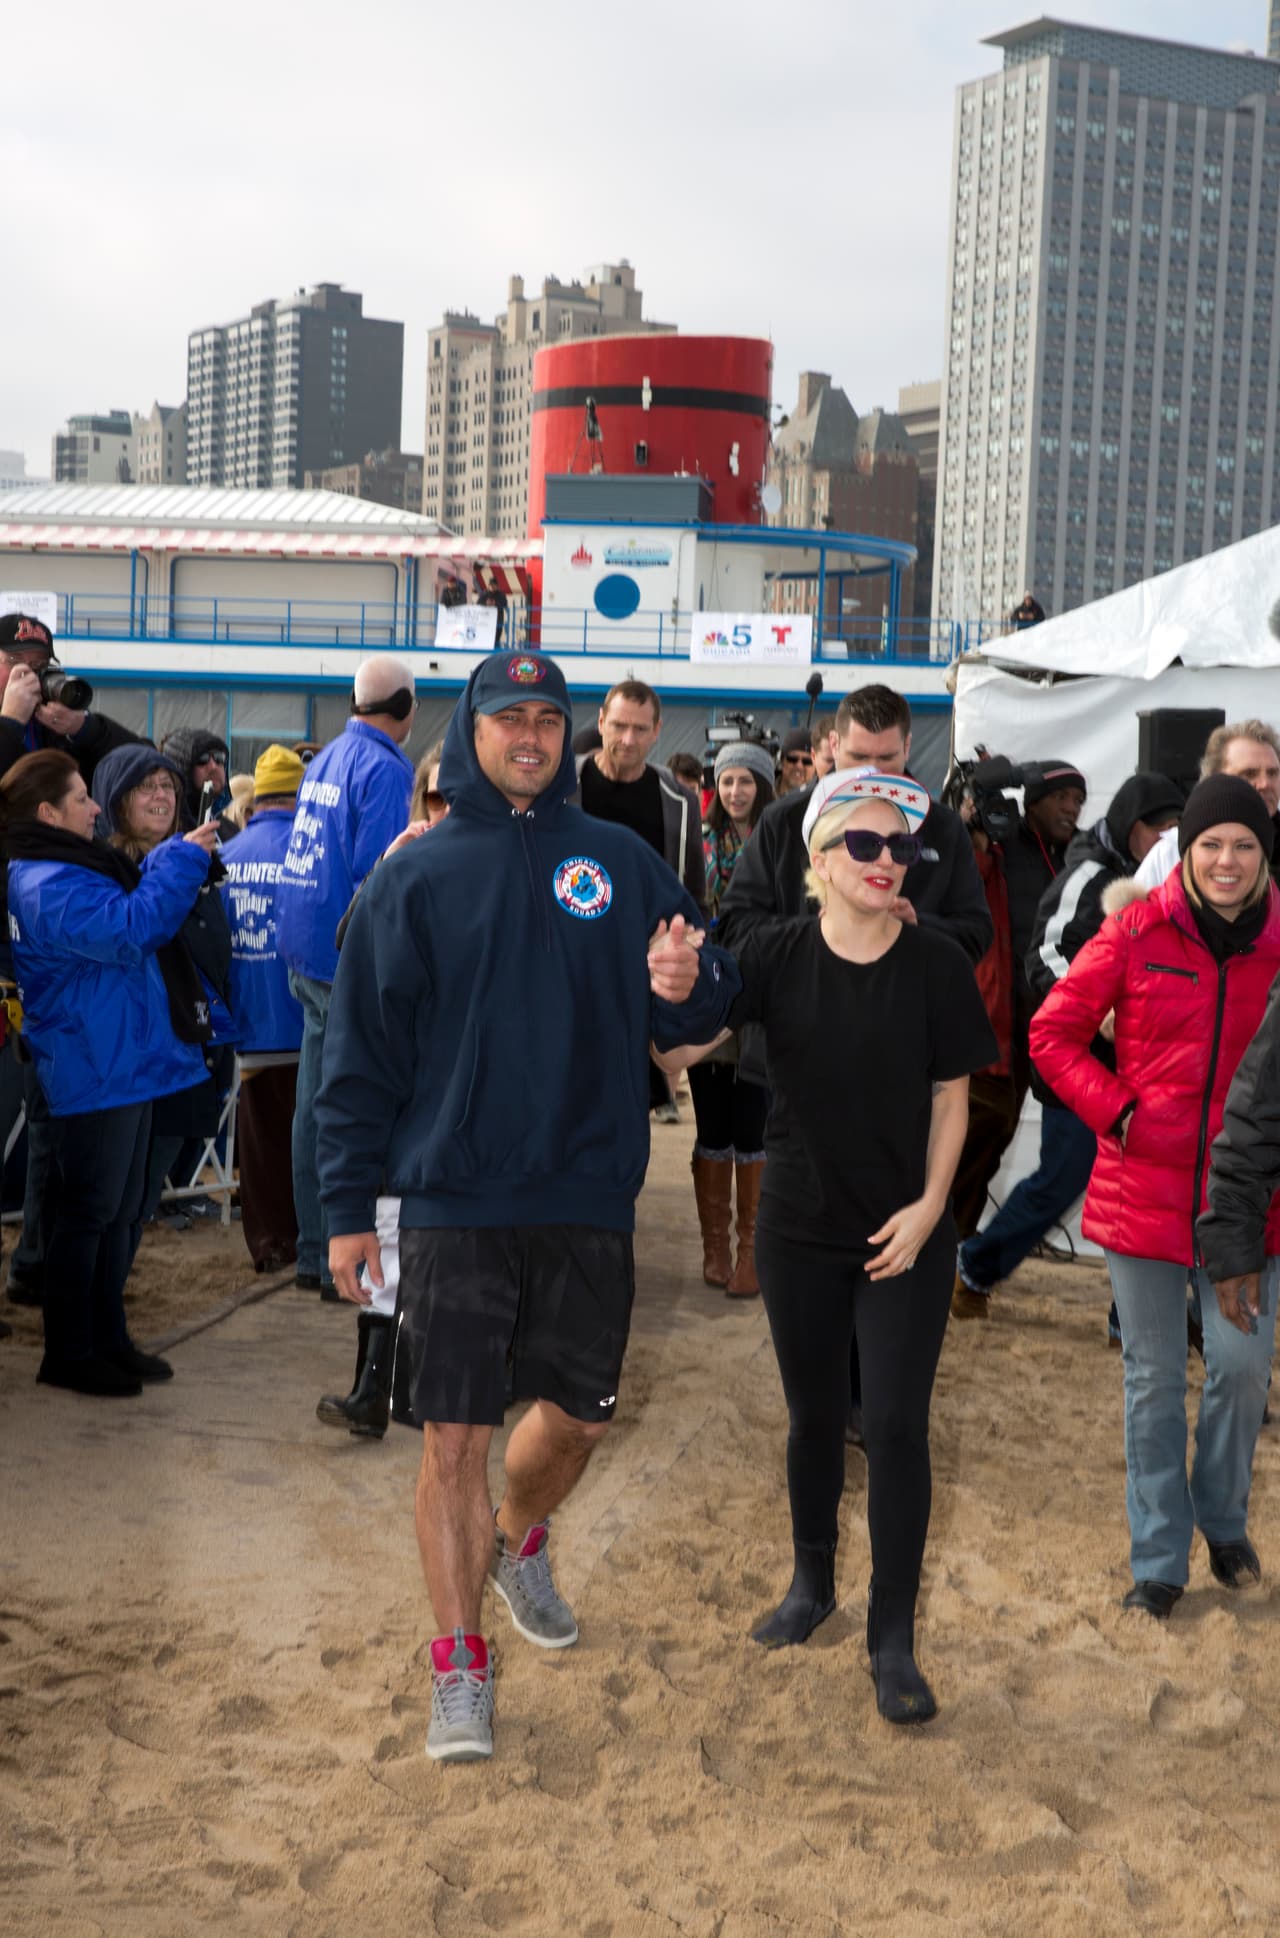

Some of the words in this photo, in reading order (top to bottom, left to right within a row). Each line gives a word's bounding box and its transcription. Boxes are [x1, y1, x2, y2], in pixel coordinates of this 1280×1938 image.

[731, 624, 752, 647] 5
[564, 858, 600, 870] CHICAGO
[569, 904, 596, 916] SQUAD
